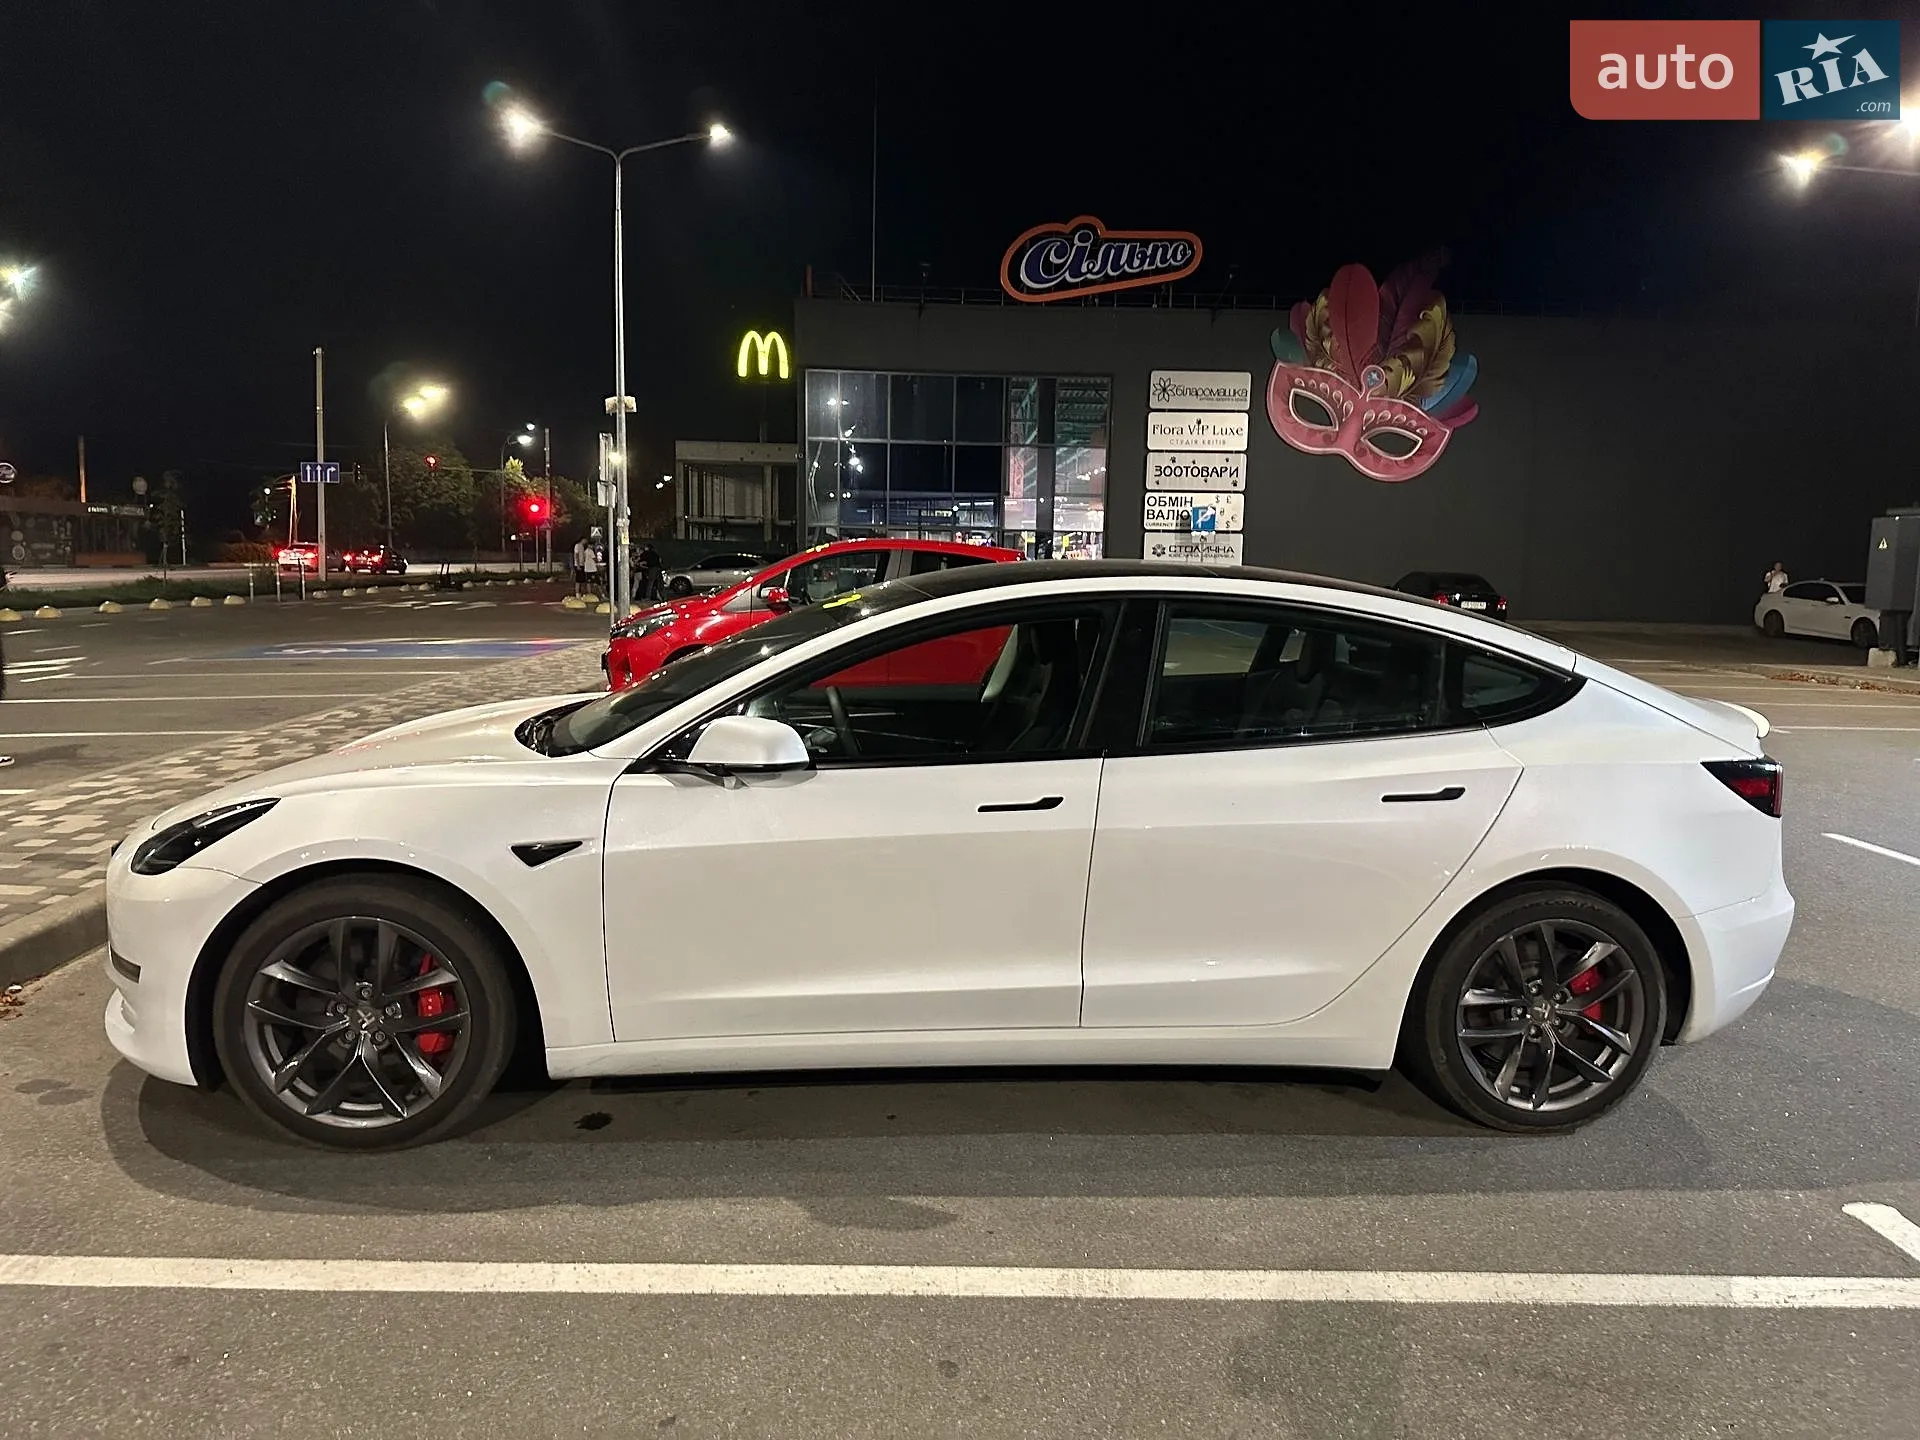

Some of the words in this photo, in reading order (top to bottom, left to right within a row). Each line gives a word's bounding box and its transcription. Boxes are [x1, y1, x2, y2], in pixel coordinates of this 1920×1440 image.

[1020, 229, 1191, 289] Сільпо
[1152, 424, 1184, 435] Flora
[1188, 424, 1209, 436] VIP
[1213, 424, 1244, 436] Luxe
[1154, 465, 1239, 478] ЗООТОВАРИ
[1146, 495, 1193, 507] ОБМІН
[1146, 509, 1192, 520] ВАЛЮ
